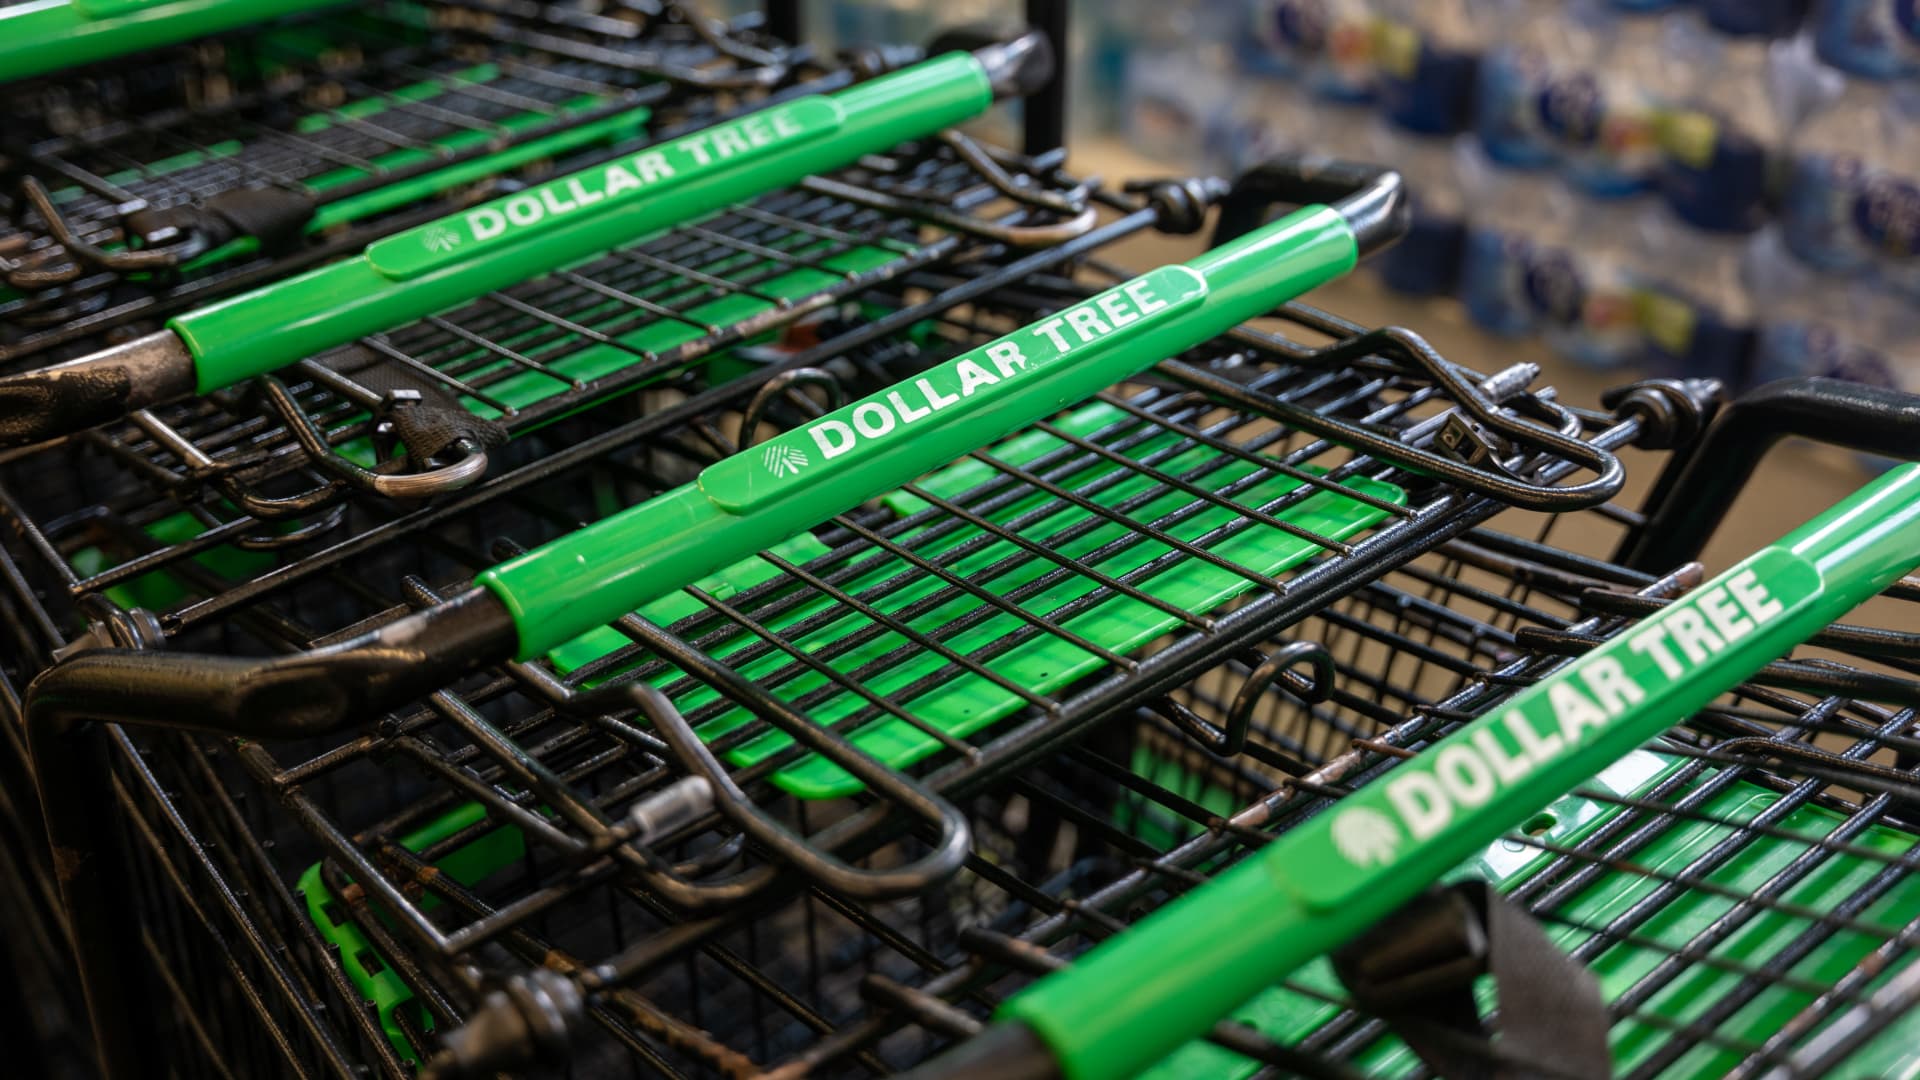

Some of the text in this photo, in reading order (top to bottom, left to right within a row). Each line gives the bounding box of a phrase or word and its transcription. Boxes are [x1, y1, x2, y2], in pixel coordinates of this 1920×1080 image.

[467, 107, 800, 241] DOLLAR TREE
[807, 279, 1168, 460] DOLLAR TREE
[1388, 569, 1783, 838] DOLLAR TREE
